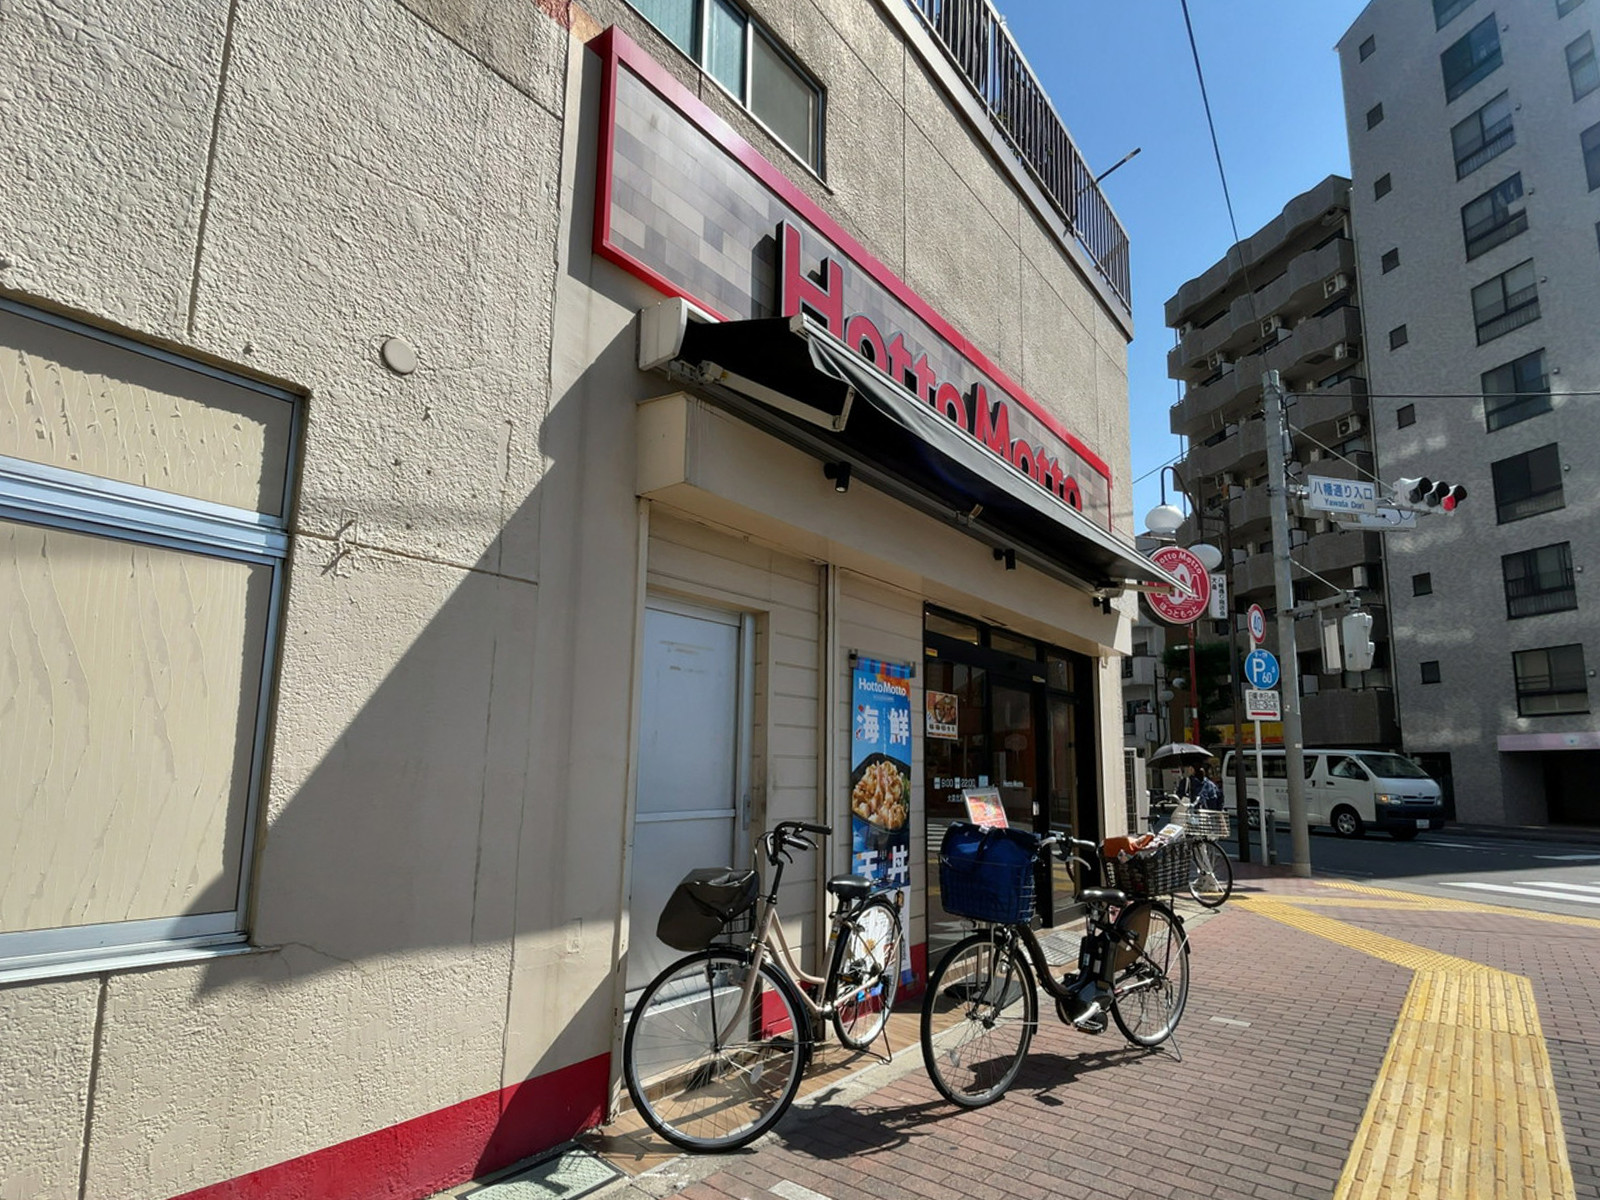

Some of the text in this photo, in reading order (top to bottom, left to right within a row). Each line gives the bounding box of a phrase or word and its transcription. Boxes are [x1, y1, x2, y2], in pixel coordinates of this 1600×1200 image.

[1313, 481, 1373, 500] 八幡通り入口
[1324, 498, 1365, 509] Yawata Dori
[1155, 552, 1202, 574] otto Motto
[1159, 602, 1199, 618] ほっともっと
[1253, 615, 1263, 633] 40
[1252, 658, 1266, 683] P
[1262, 671, 1273, 684] 60
